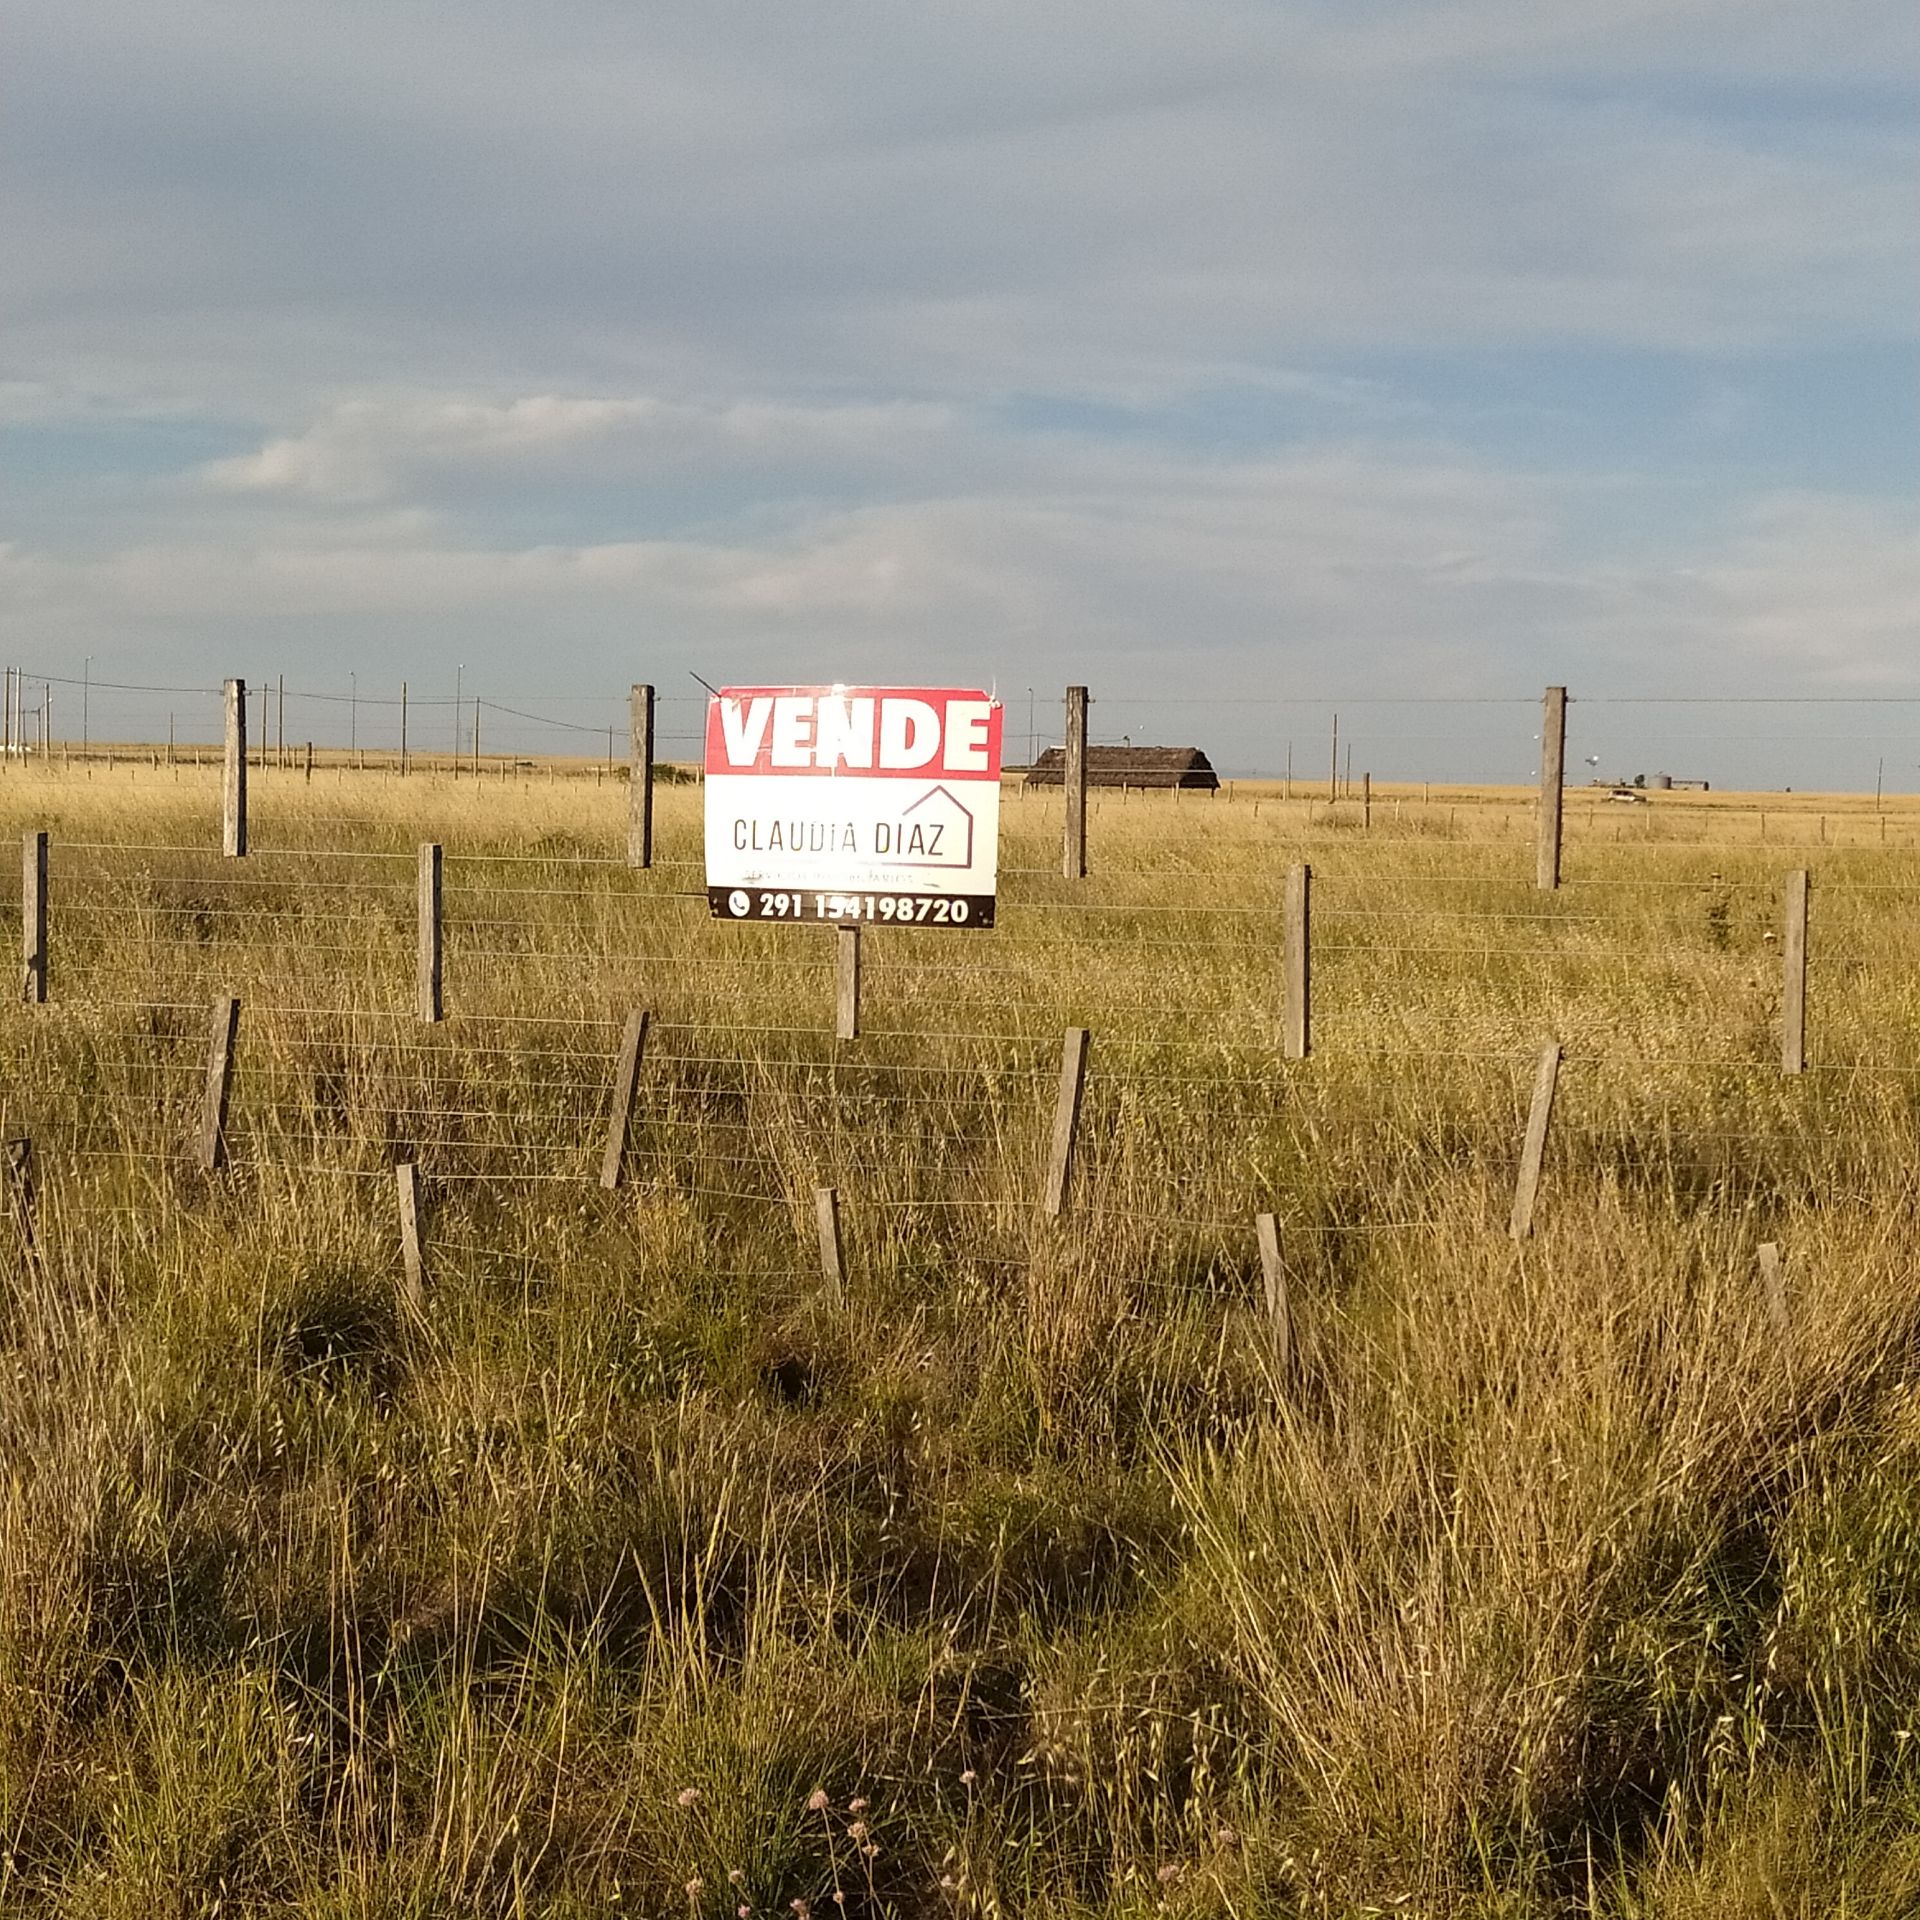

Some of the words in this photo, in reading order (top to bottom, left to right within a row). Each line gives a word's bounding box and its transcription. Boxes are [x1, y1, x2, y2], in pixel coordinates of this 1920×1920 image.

[720, 696, 992, 772] VENDE
[734, 819, 857, 853] CLAUDIA
[875, 822, 945, 856] DIAZ
[760, 893, 802, 917] 291
[815, 894, 969, 923] 154198720
